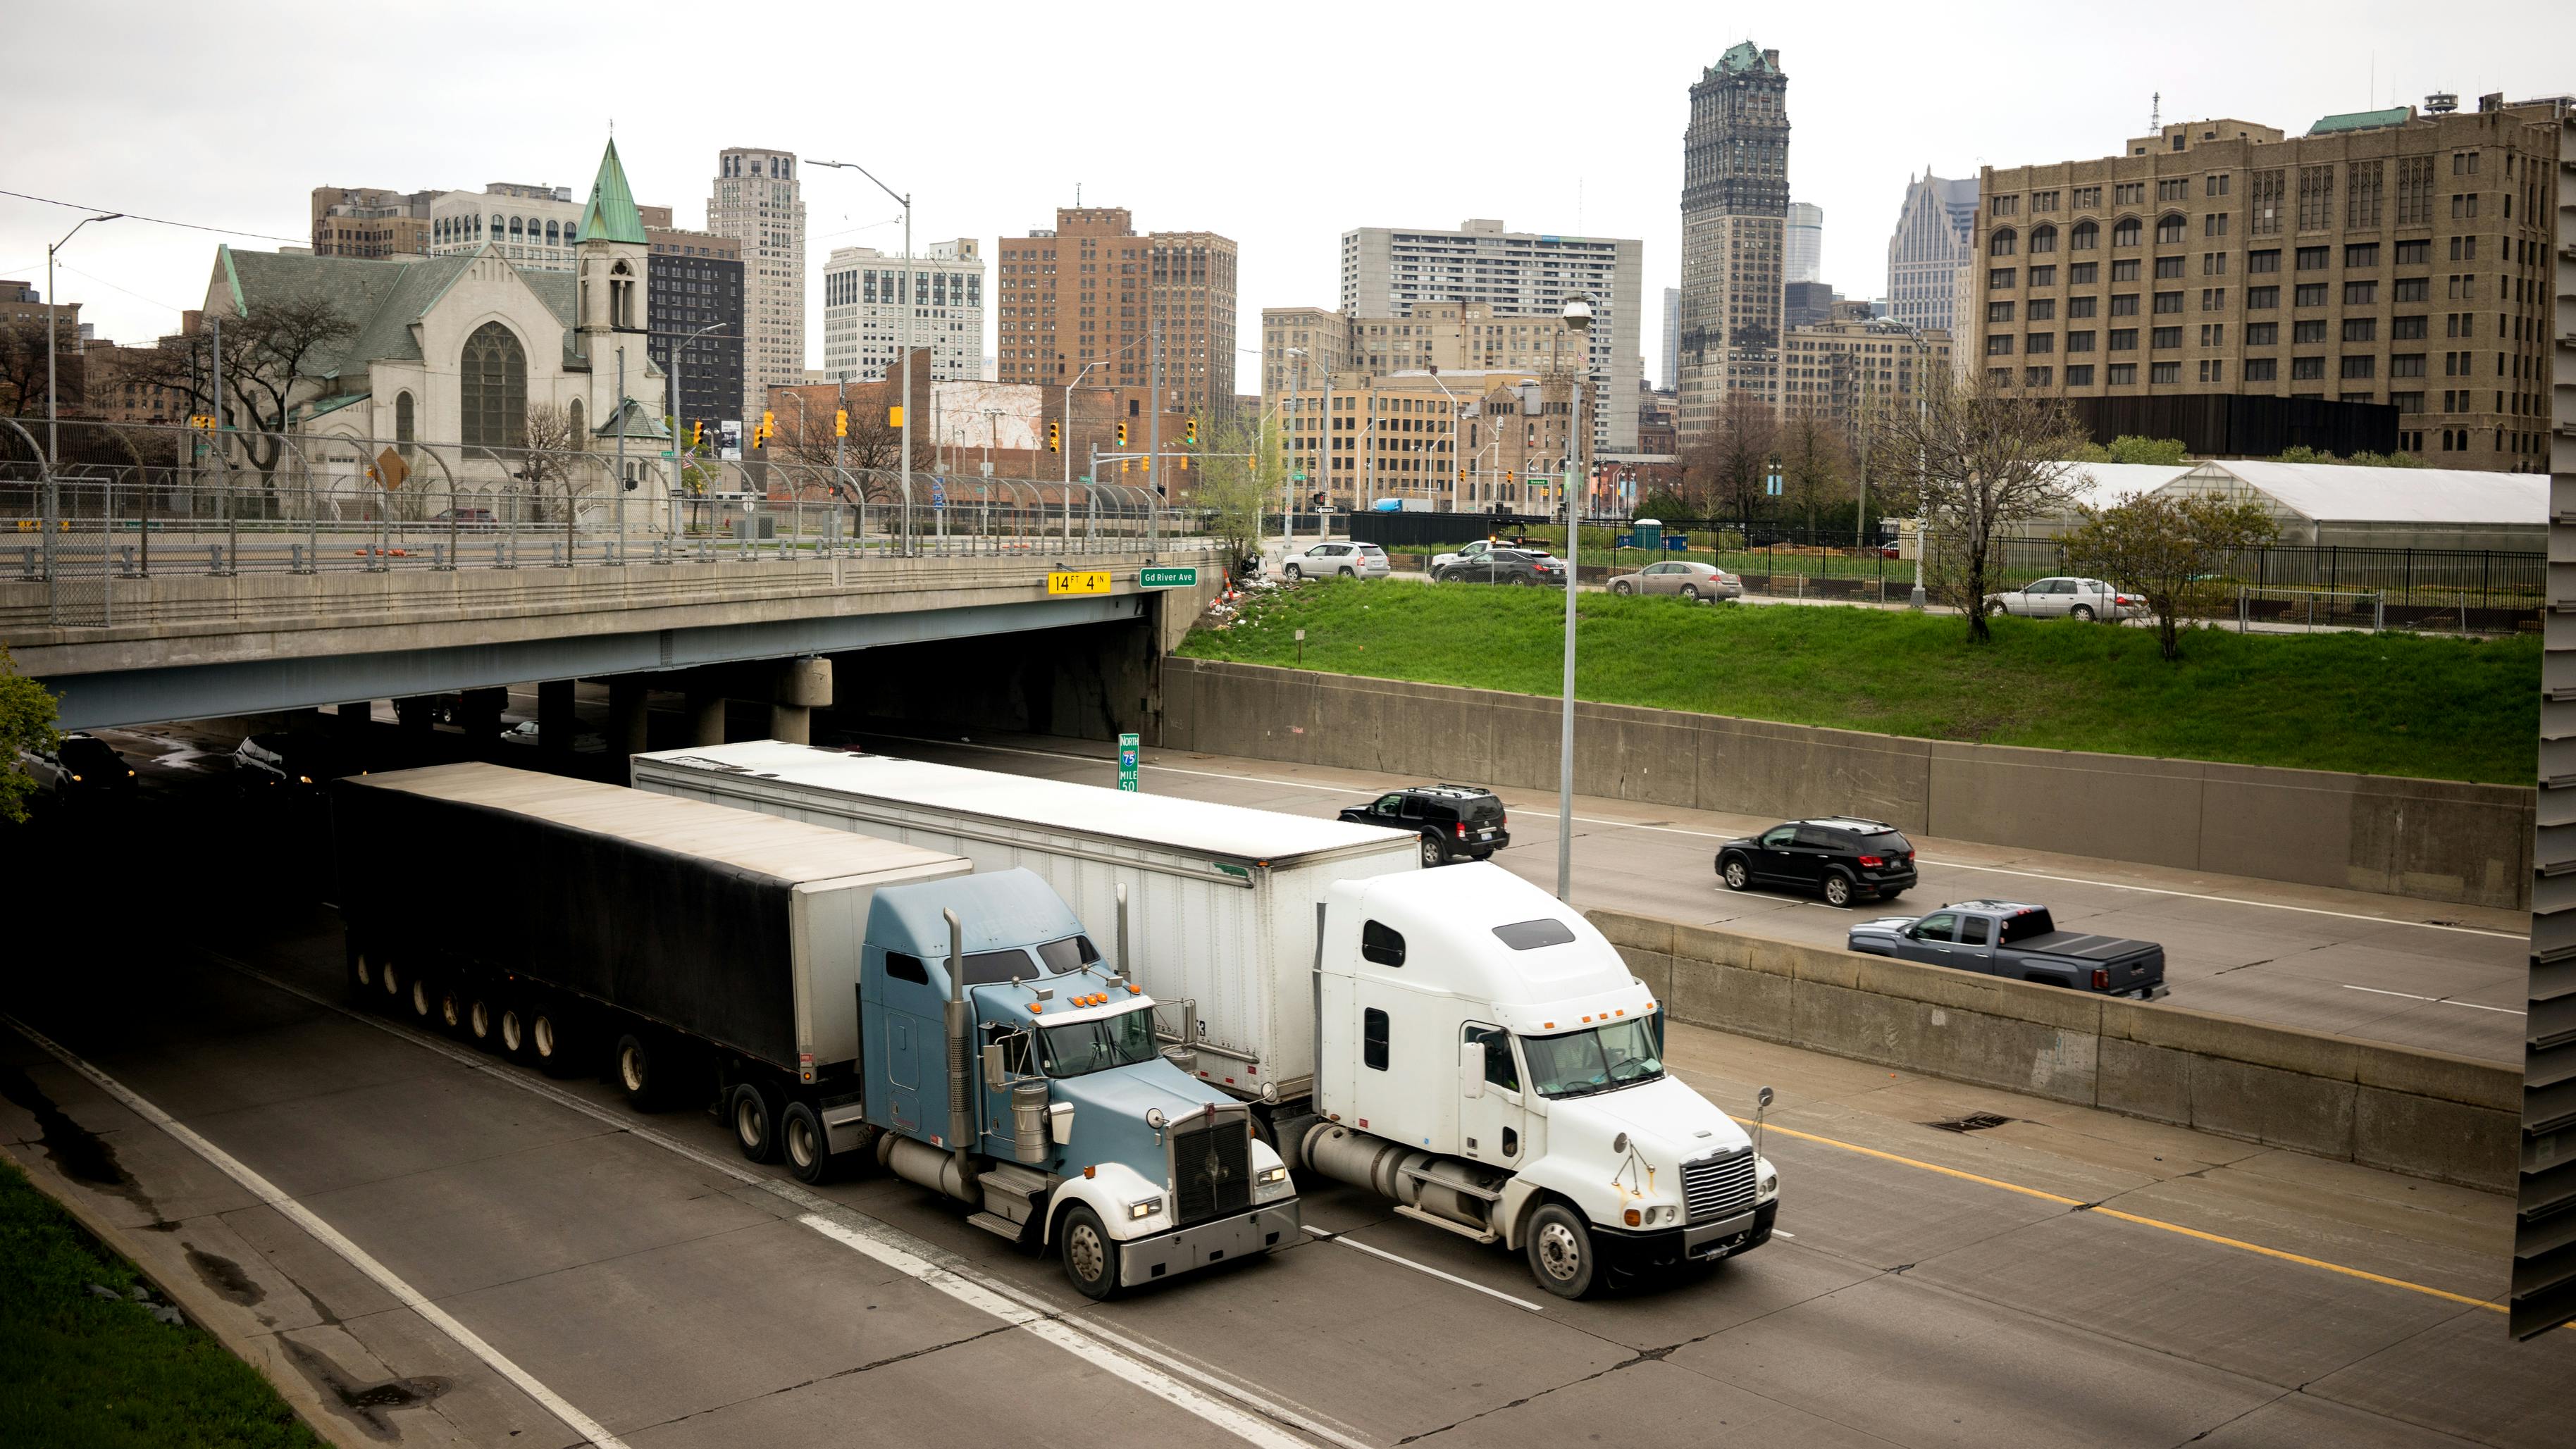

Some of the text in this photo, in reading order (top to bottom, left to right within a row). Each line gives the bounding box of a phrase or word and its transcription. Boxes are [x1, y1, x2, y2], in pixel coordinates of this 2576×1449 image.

[1145, 573, 1192, 582] Gd River Ave
[1056, 576, 1069, 591] 14
[1086, 576, 1094, 590] 4
[1097, 575, 1104, 583] IN
[1120, 736, 1139, 746] NORTH
[1124, 754, 1134, 764] 75
[1120, 771, 1137, 780] MILE
[1122, 781, 1134, 792] 50
